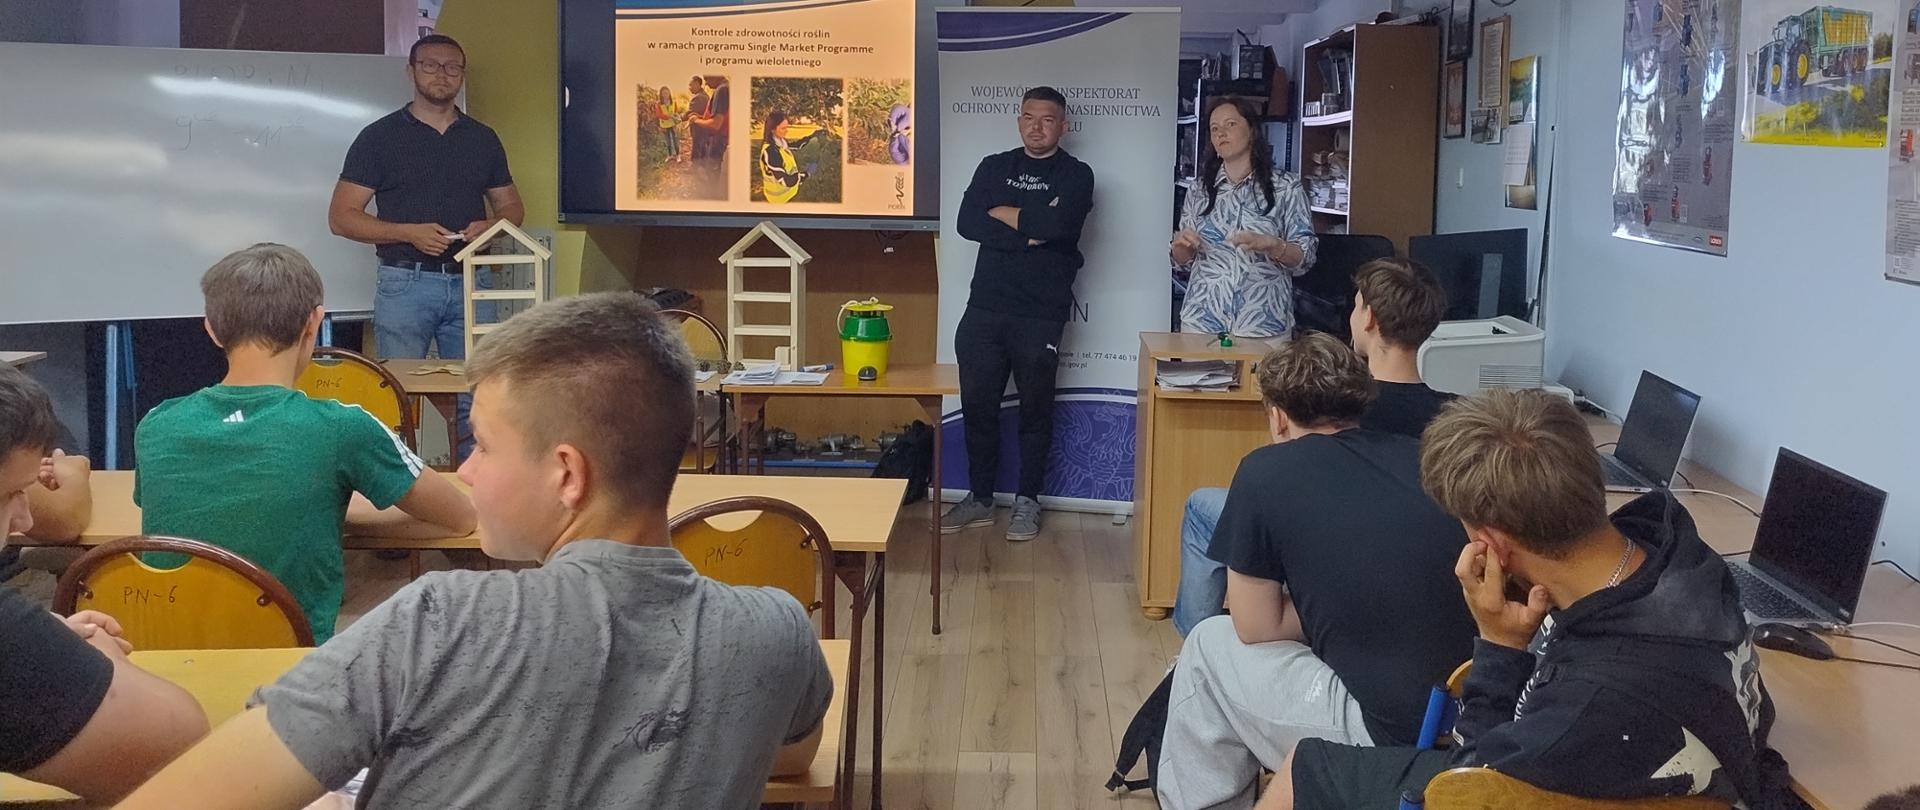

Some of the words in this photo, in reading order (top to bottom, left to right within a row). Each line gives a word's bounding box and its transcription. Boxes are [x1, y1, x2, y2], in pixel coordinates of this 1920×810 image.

[691, 27, 733, 37] Kontrole
[736, 28, 801, 38] zdrowotności
[803, 29, 830, 39] roślin
[659, 41, 695, 50] ramach
[697, 43, 745, 53] programu
[748, 43, 776, 53] Single
[780, 43, 815, 52] Market
[818, 44, 874, 54] Programme
[706, 57, 753, 67] programu
[756, 57, 822, 68] wieloletniego
[970, 85, 1031, 99] WOJEWÓ
[952, 102, 1010, 114] OCHRONY
[1066, 104, 1161, 117] NASIENNICTWA
[1094, 352, 1103, 360] 77
[704, 538, 748, 567] PN-6
[124, 585, 178, 605] PN-6
